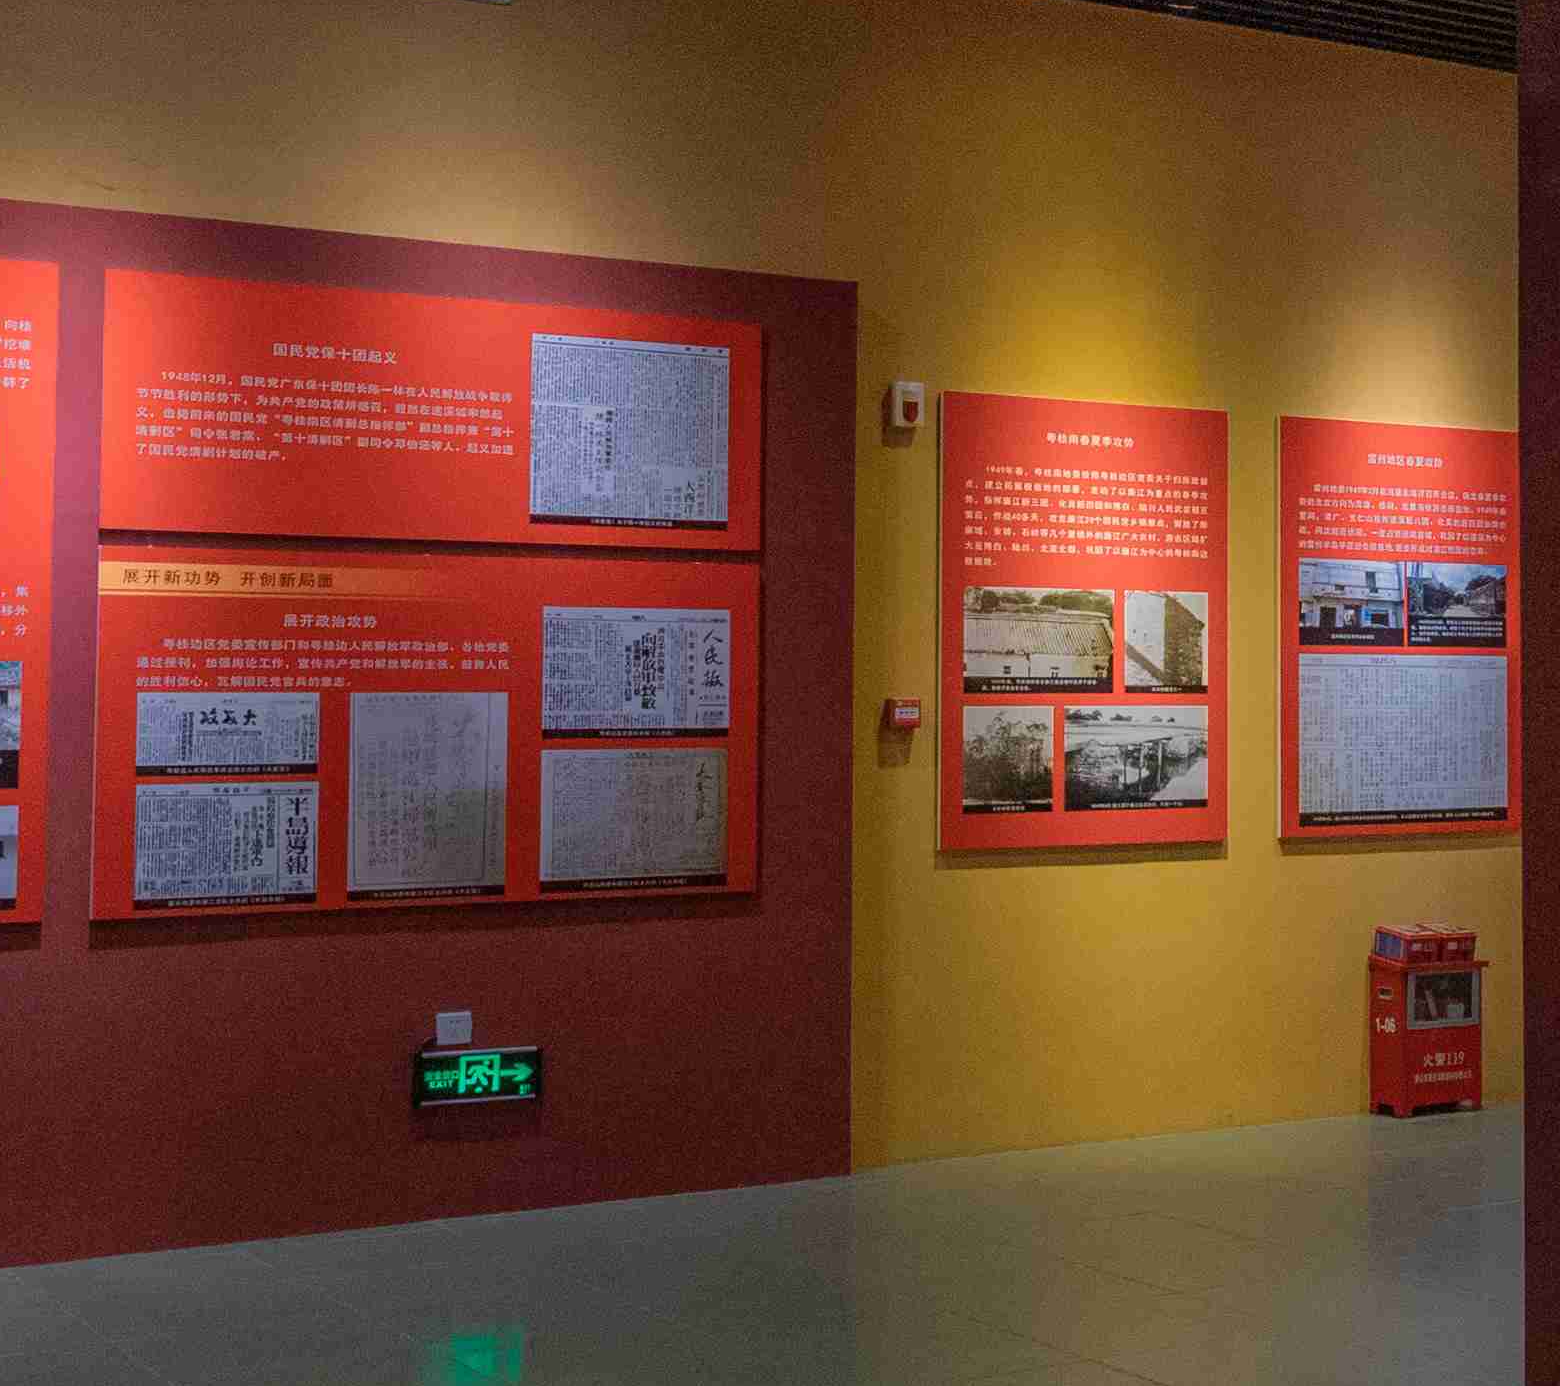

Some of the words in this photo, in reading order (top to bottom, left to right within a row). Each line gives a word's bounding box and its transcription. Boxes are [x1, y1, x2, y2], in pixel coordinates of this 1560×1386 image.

[239, 571, 335, 589] 开创新局面
[429, 1079, 453, 1089] EXIT
